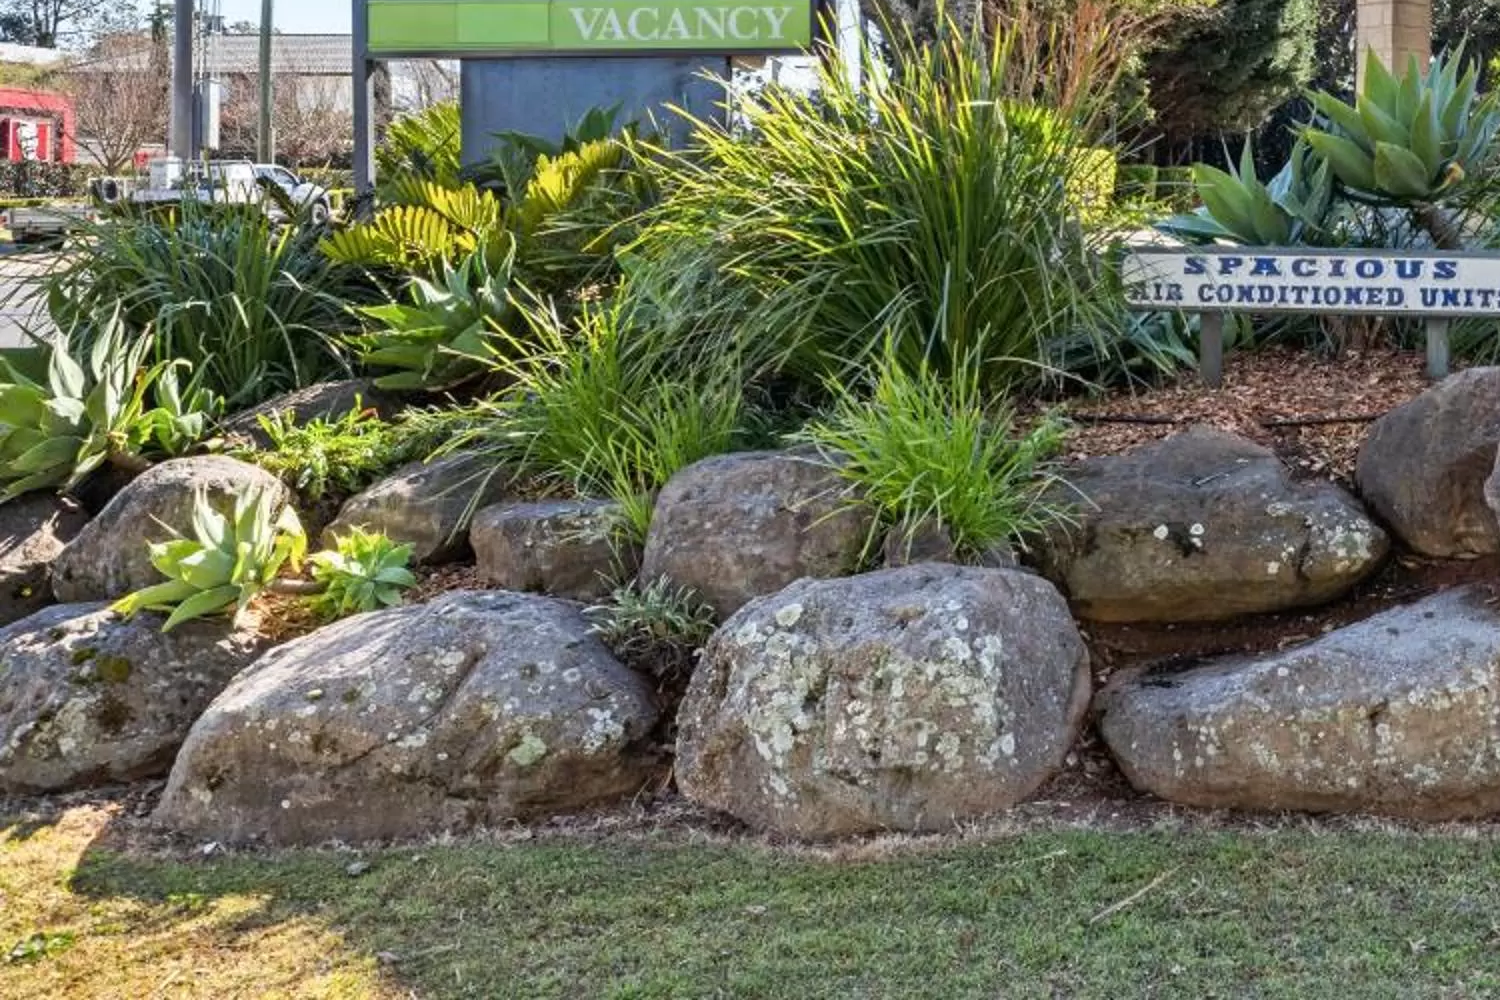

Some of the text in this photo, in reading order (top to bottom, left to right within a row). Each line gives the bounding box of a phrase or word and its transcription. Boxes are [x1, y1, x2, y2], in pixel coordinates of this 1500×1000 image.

[568, 6, 792, 41] VACANCY
[1183, 256, 1458, 280] SPACIOUS
[1198, 284, 1405, 308] CONDITIONED
